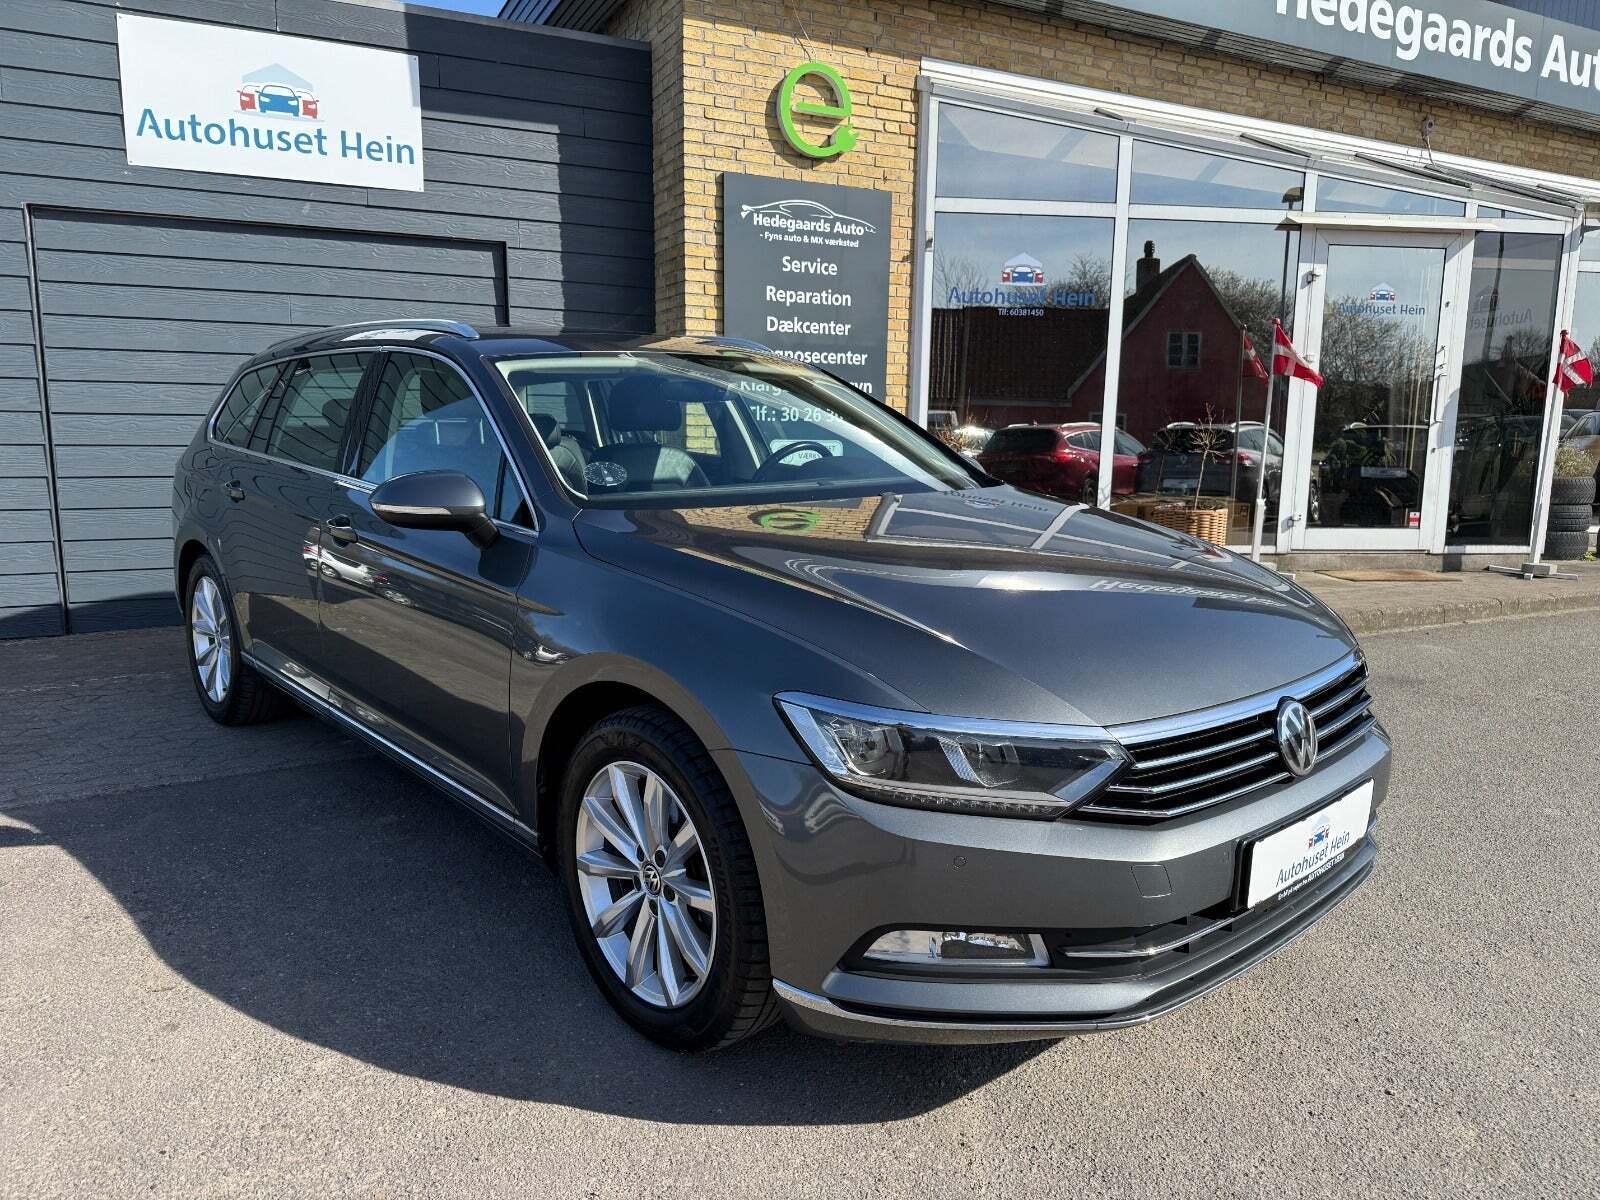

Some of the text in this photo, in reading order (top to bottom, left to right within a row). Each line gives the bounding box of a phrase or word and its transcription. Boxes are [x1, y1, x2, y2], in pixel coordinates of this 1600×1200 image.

[136, 108, 415, 165] Autohuset Hein
[752, 213, 865, 236] Hedegaards Auto
[764, 231, 783, 242] Fyns
[784, 234, 802, 243] auto
[802, 235, 810, 243] &
[810, 236, 824, 245] MX
[824, 238, 859, 248] værksted
[782, 256, 838, 276] Service
[766, 285, 852, 307] Reparation
[949, 286, 1096, 306] Autohuset Hein
[1010, 308, 1044, 317] 60381450
[1338, 302, 1426, 316] Autohuset Hein
[766, 316, 852, 336] Dækcenter
[780, 407, 800, 422] 30
[803, 407, 822, 423] 26
[1276, 831, 1350, 888] Autohuset Hein
